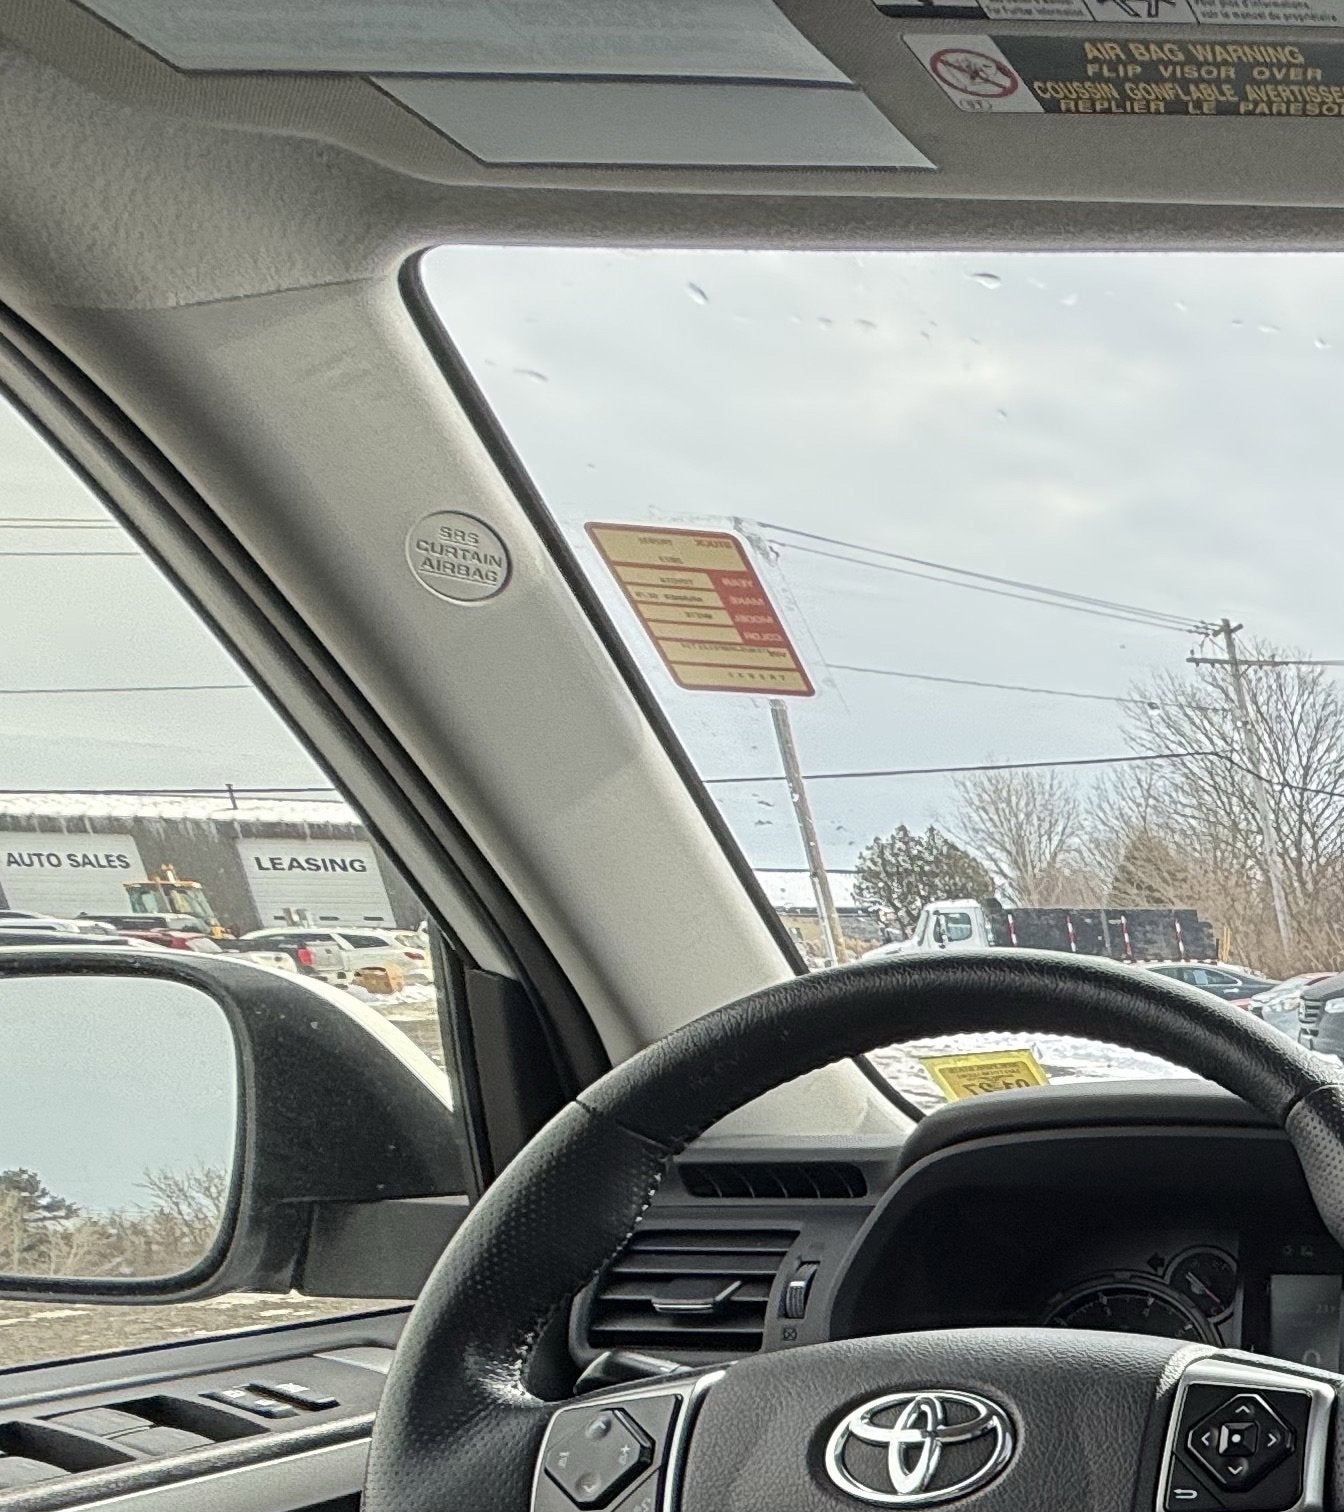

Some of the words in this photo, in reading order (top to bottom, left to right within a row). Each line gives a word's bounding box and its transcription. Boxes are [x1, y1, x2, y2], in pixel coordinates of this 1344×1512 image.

[1082, 41, 1126, 61] AIR
[1128, 43, 1185, 62] BAG
[1189, 43, 1304, 64] WARNING
[1087, 64, 1141, 78] FLIP
[1159, 65, 1236, 79] VISOR
[1253, 67, 1322, 81] OVER
[1033, 80, 1120, 99] COUSSIN
[1060, 100, 1165, 114] REPLIER
[1188, 101, 1217, 115] LE
[440, 526, 480, 545] SRS
[416, 539, 502, 569] CURTAIN
[420, 557, 498, 583] AIRBAG
[6, 852, 62, 869] AUTO
[66, 853, 131, 870] SALES
[254, 856, 367, 874] LEASING
